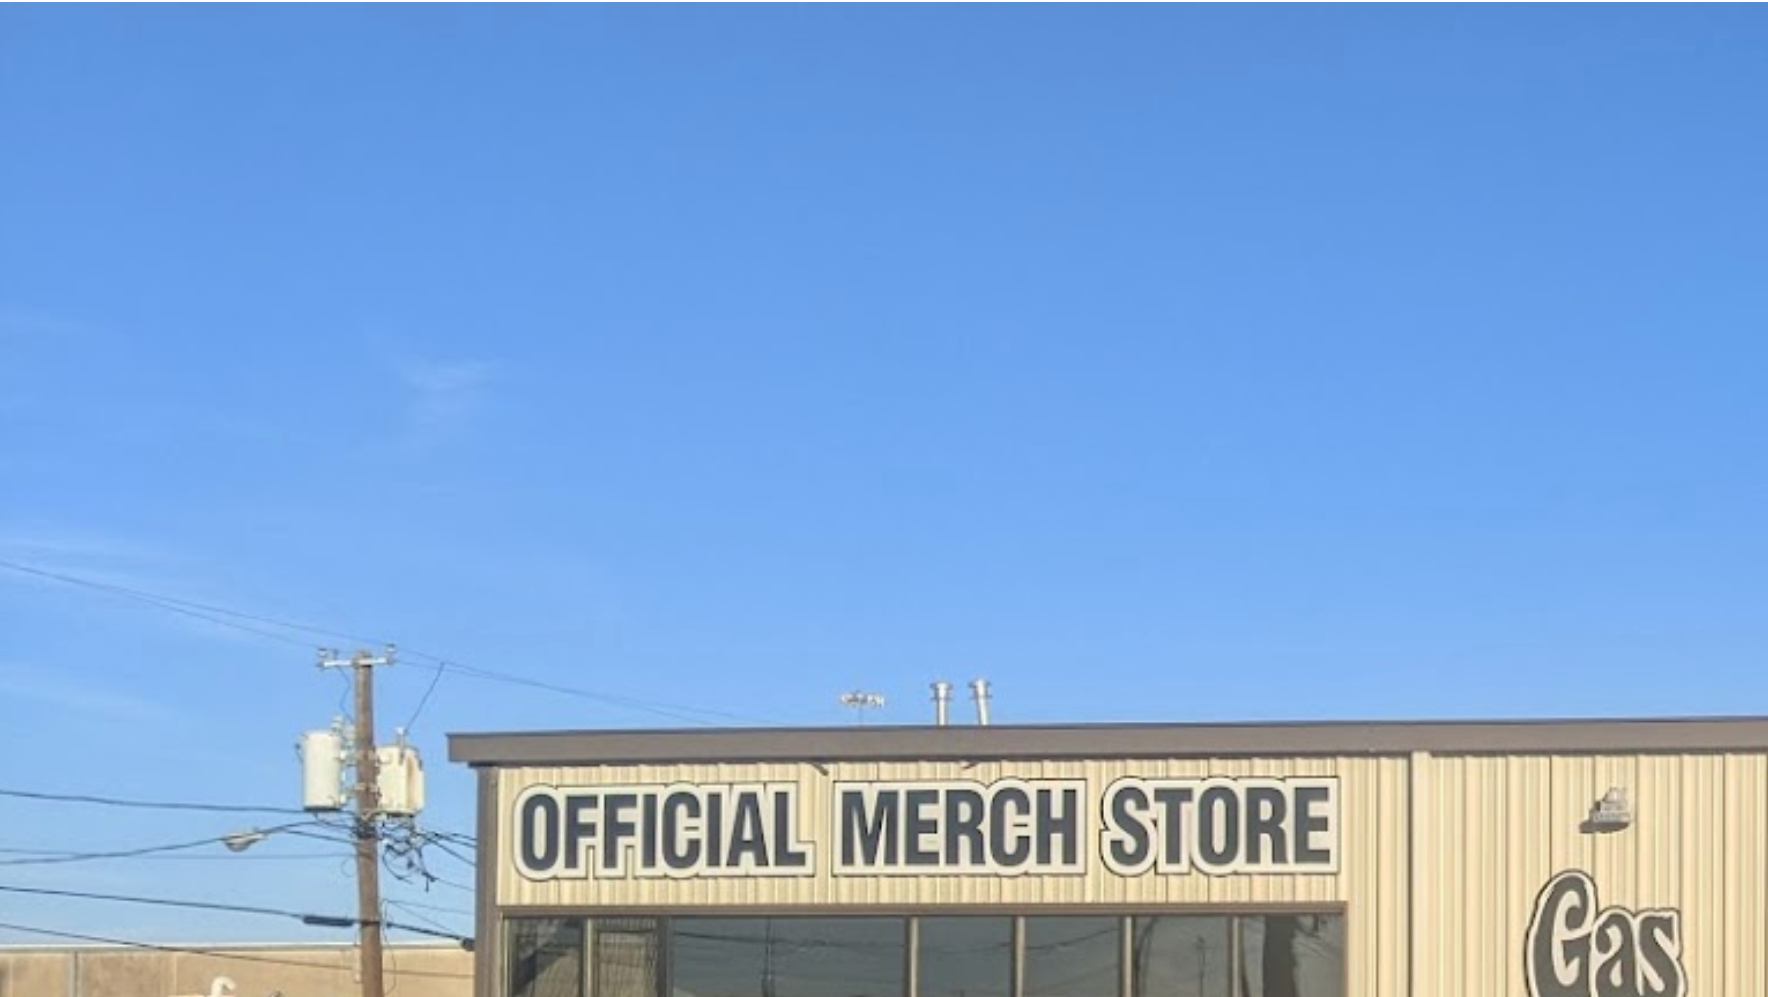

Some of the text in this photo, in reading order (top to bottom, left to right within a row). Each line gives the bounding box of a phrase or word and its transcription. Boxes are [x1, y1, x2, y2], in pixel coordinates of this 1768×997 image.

[518, 784, 1334, 871] OFFICIAL MERCH STORE
